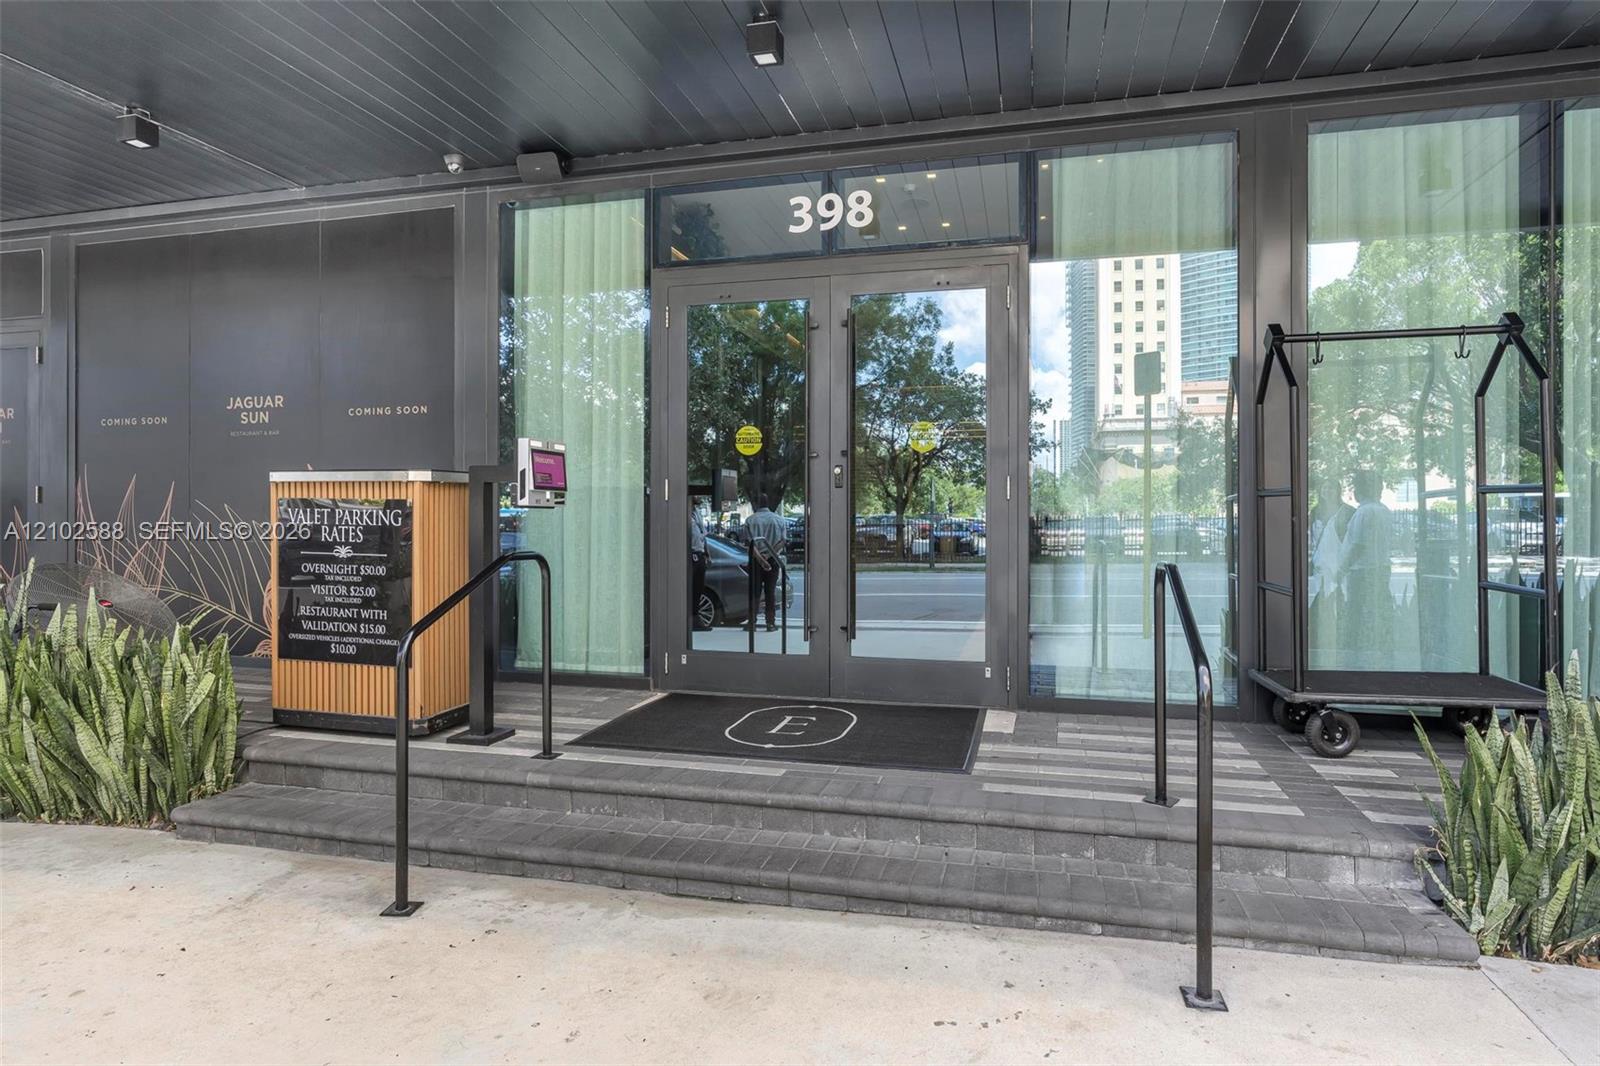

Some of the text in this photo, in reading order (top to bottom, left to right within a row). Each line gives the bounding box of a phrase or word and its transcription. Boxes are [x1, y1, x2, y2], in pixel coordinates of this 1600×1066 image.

[788, 190, 874, 233] 398
[226, 395, 284, 409] JAGUAR
[240, 411, 269, 424] SUN
[347, 405, 428, 416] COMING SOON
[100, 416, 168, 426] COMING SOON
[288, 508, 402, 526] VALET PARKING
[321, 525, 364, 543] RATES
[301, 562, 387, 576] OVERNIGHT $50.00
[311, 584, 376, 597] VISITOR $25.00
[300, 605, 388, 620] RESTAURANT WITH
[301, 619, 386, 634] VALIDATION $15.00
[288, 633, 316, 641] OVERSIZED
[316, 634, 340, 642] VEHICLES
[330, 643, 357, 655] $10.00
[765, 715, 816, 735] E
